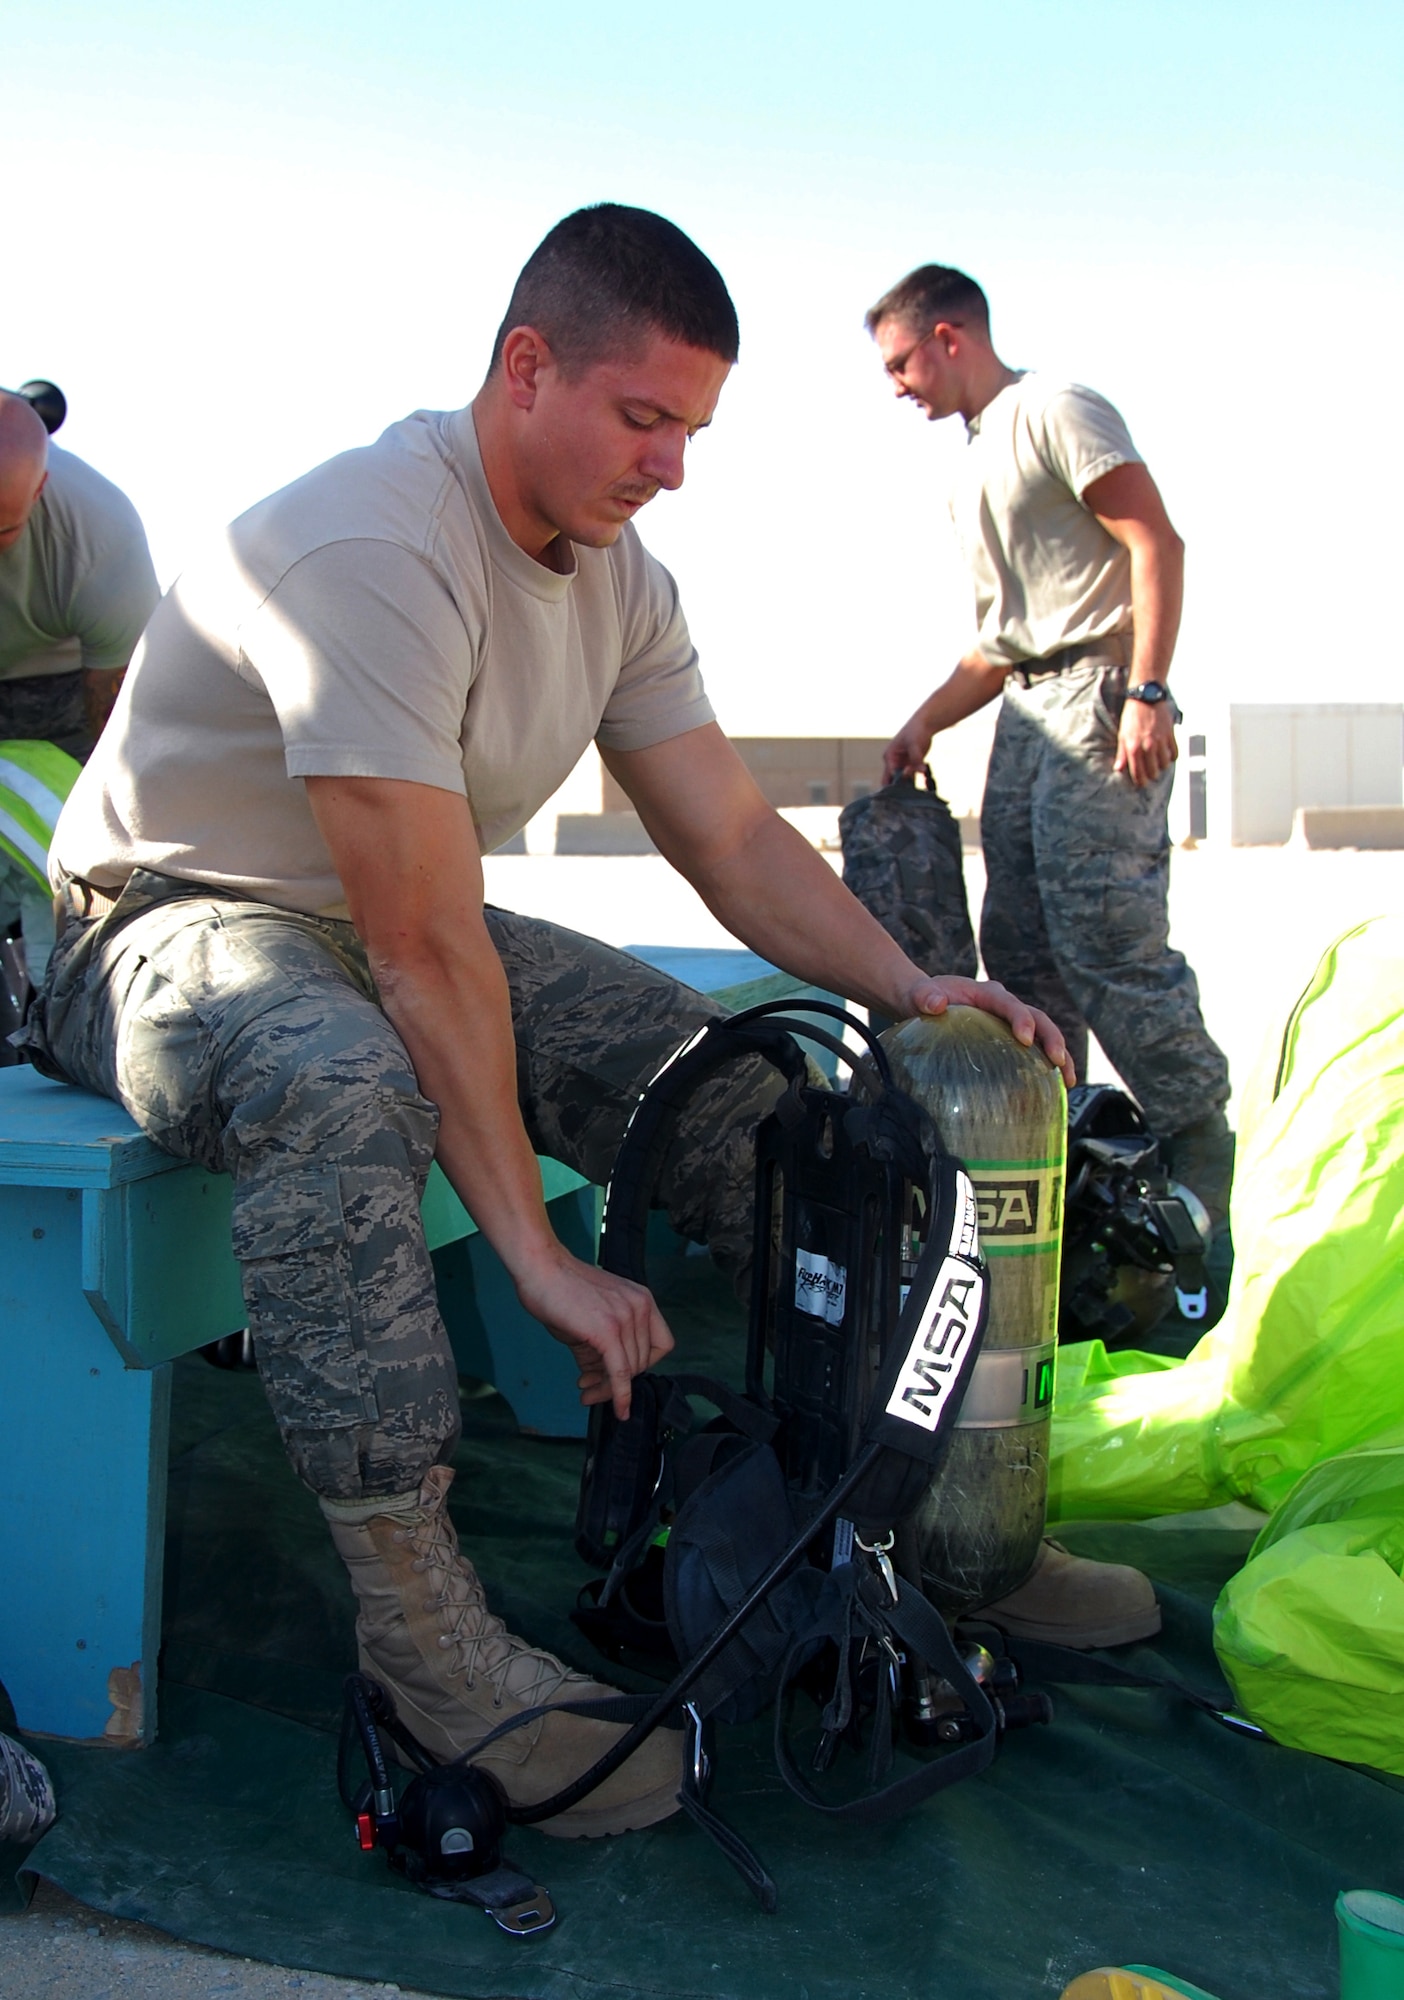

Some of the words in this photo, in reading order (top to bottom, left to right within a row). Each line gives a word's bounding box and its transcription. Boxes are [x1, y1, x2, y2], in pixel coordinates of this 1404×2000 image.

[974, 1188, 1033, 1228] SA
[901, 1276, 976, 1417] MSA
[366, 1724, 388, 1785] WARNING
